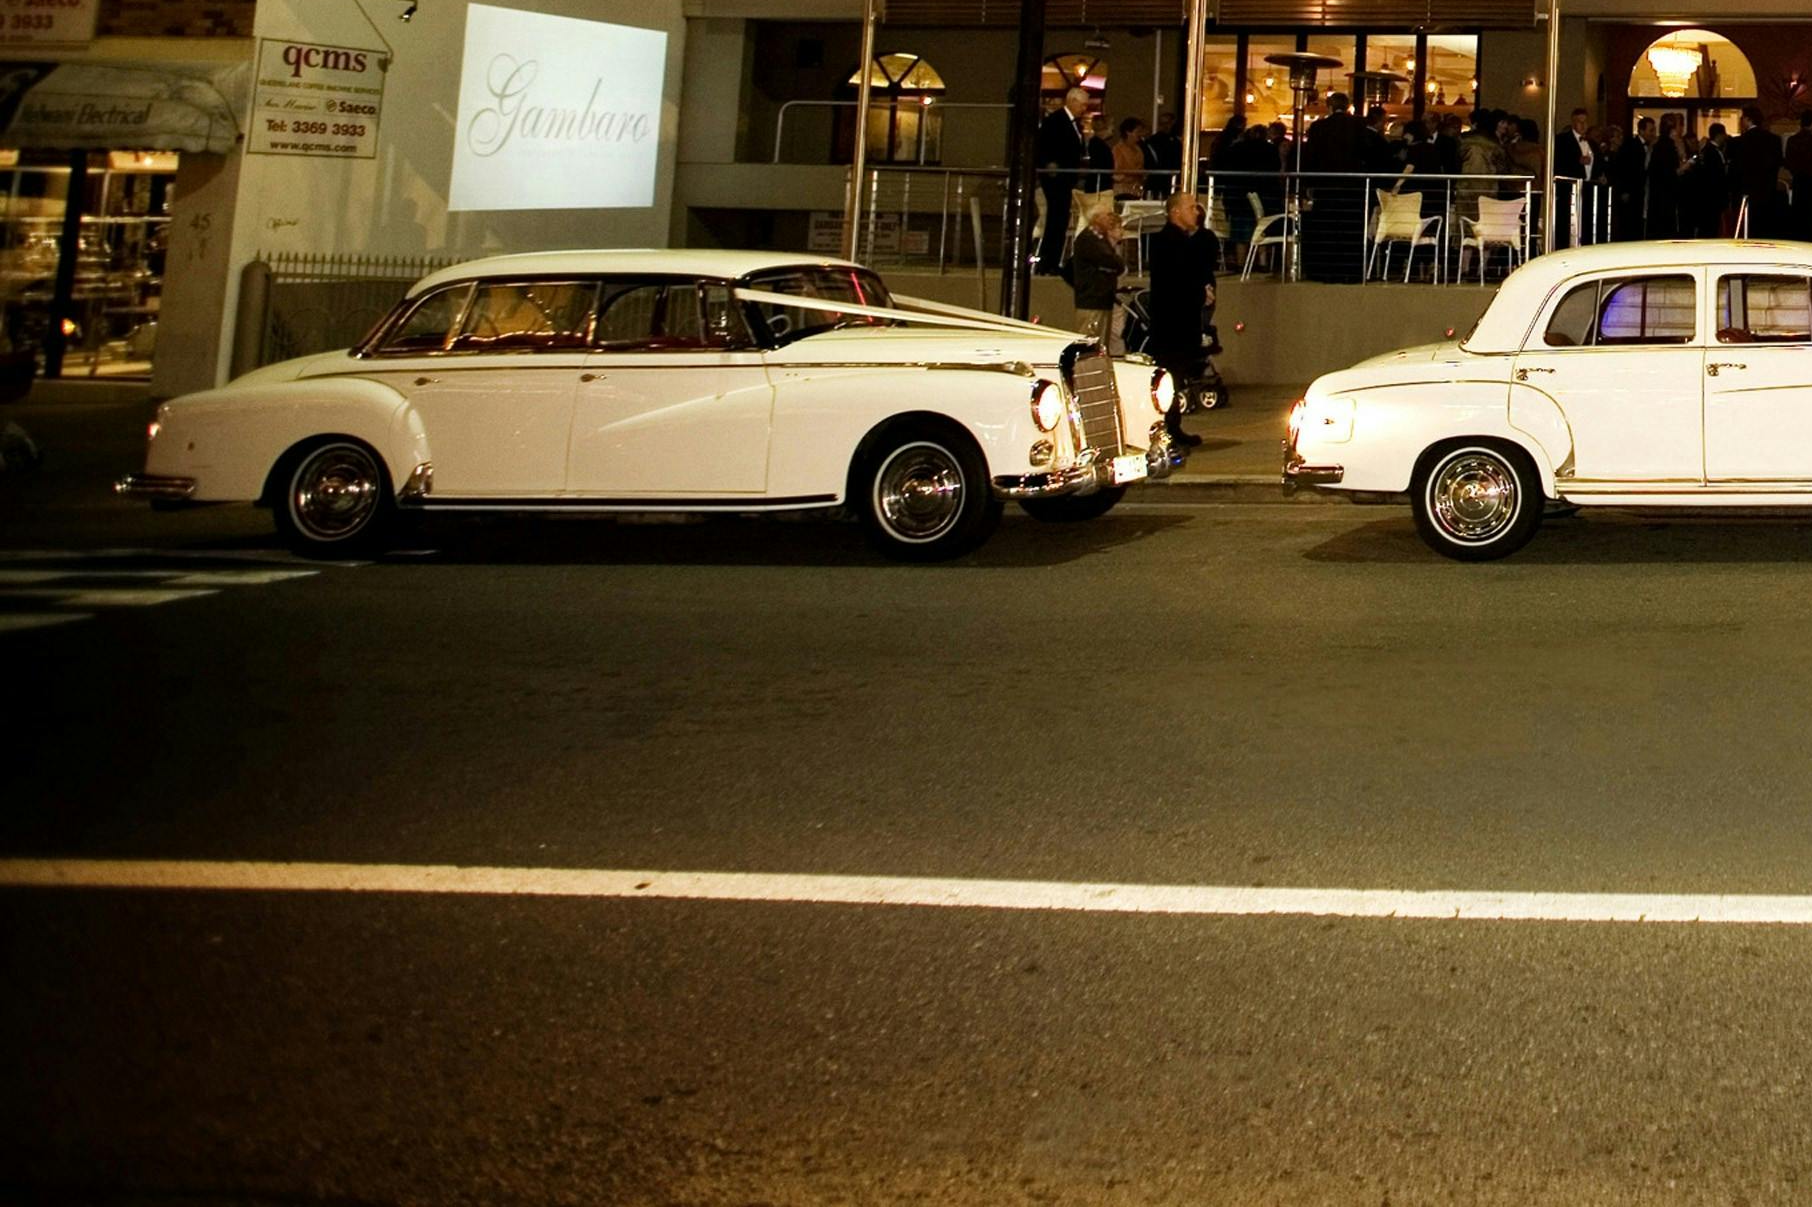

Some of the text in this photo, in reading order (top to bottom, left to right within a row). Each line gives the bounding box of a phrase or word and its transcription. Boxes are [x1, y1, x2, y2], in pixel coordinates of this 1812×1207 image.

[282, 45, 368, 78] qcms
[338, 101, 376, 115] Saeco
[467, 52, 651, 158] Gambaro
[266, 119, 366, 136] Tel: 3369 3933
[270, 141, 357, 153] www.qcms.com
